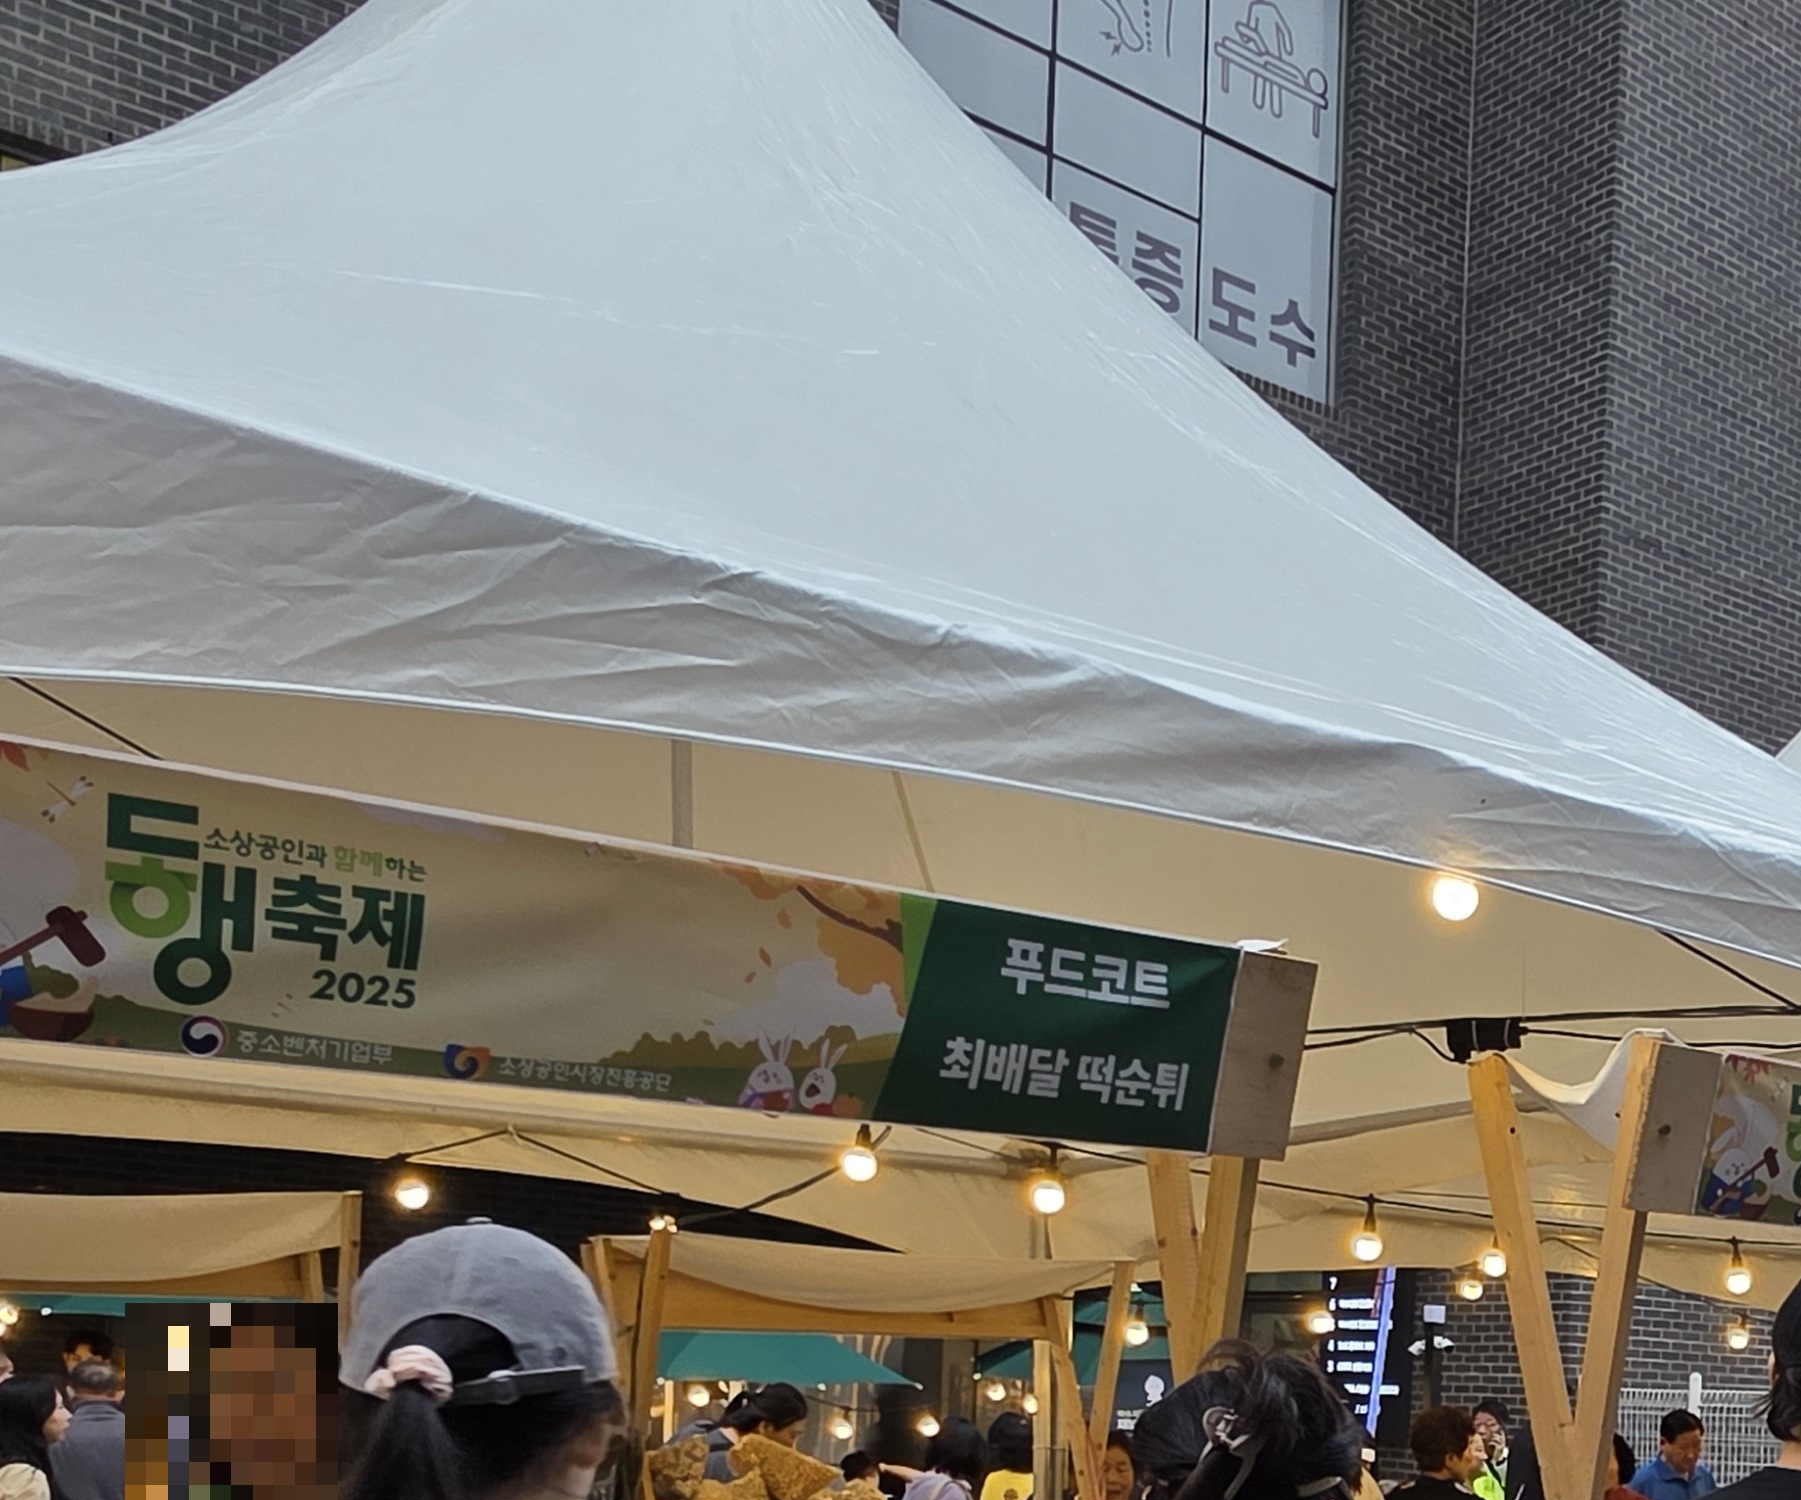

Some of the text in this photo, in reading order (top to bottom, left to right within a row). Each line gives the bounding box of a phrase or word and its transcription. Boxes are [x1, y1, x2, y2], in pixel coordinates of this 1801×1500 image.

[1208, 266, 1316, 367] 도수
[204, 828, 427, 882] 소상공인과 함께하는
[309, 969, 416, 1009] 2025
[1001, 938, 1170, 1009] 푸드코트
[236, 1030, 393, 1065] 중소벤처기업부
[499, 1057, 671, 1092] 소상공인시장진흥공단
[939, 1037, 1189, 1111] 최배달 떡순튀
